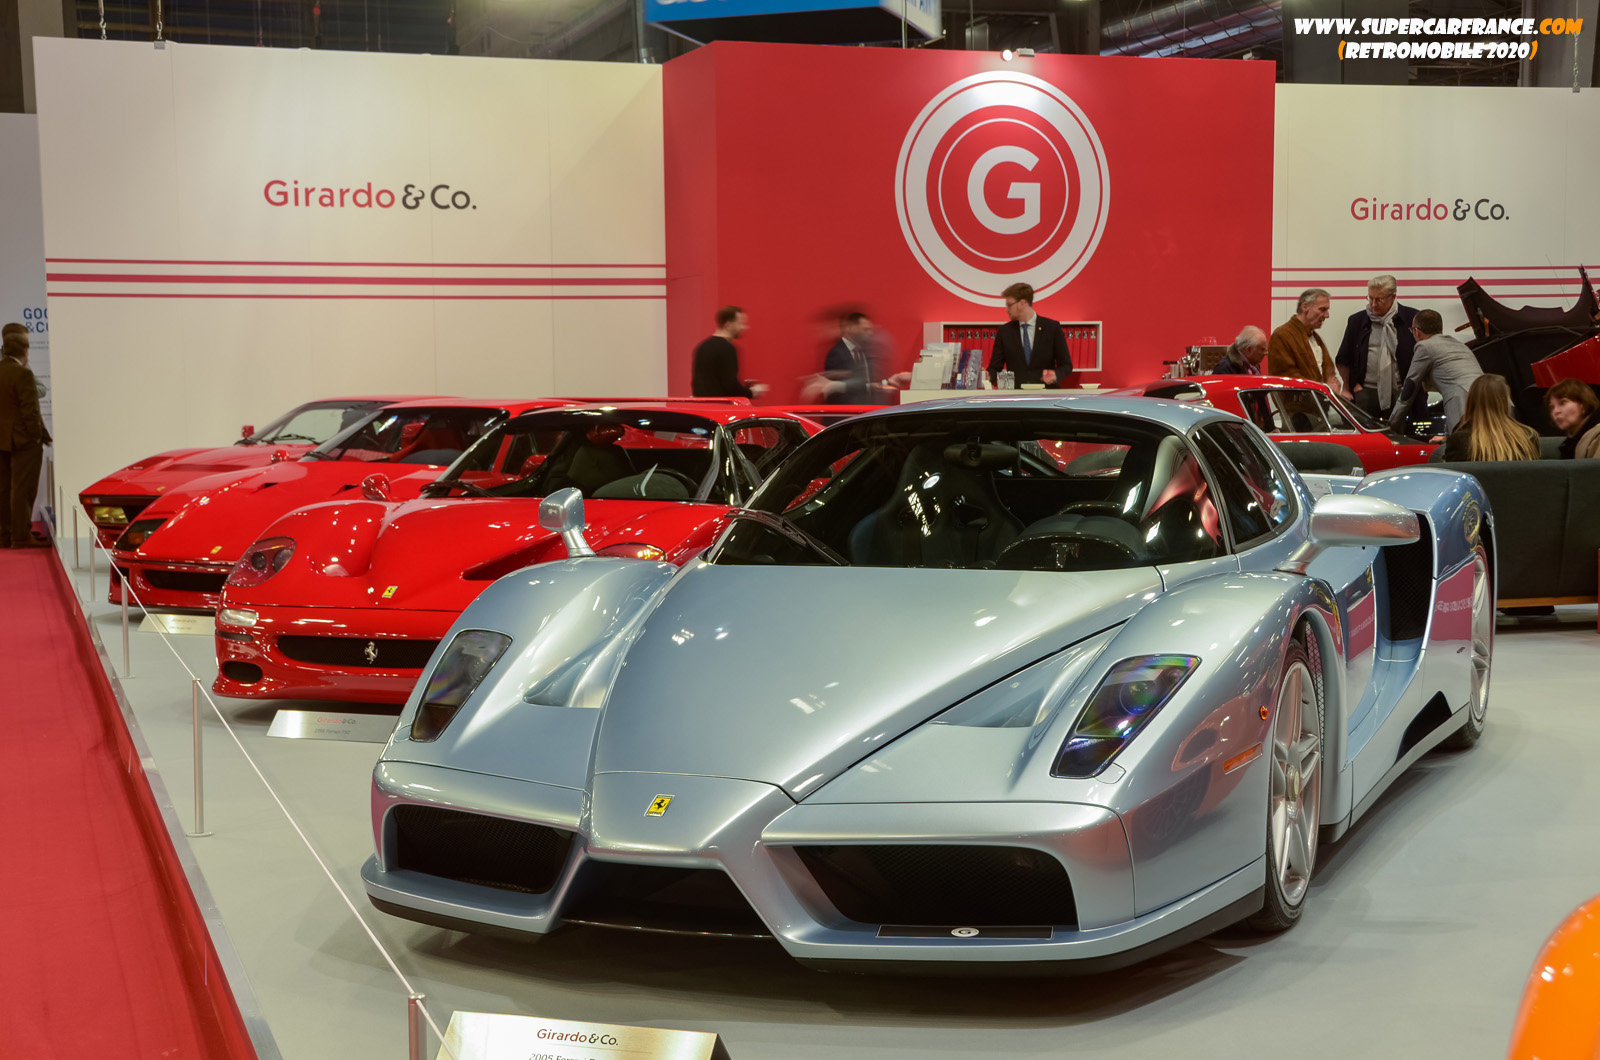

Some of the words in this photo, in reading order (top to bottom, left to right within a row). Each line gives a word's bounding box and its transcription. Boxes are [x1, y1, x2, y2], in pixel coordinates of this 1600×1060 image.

[263, 179, 396, 209] Girardo
[967, 145, 1041, 235] G
[1350, 197, 1449, 221] Girardo
[536, 1028, 588, 1043] Girardo
